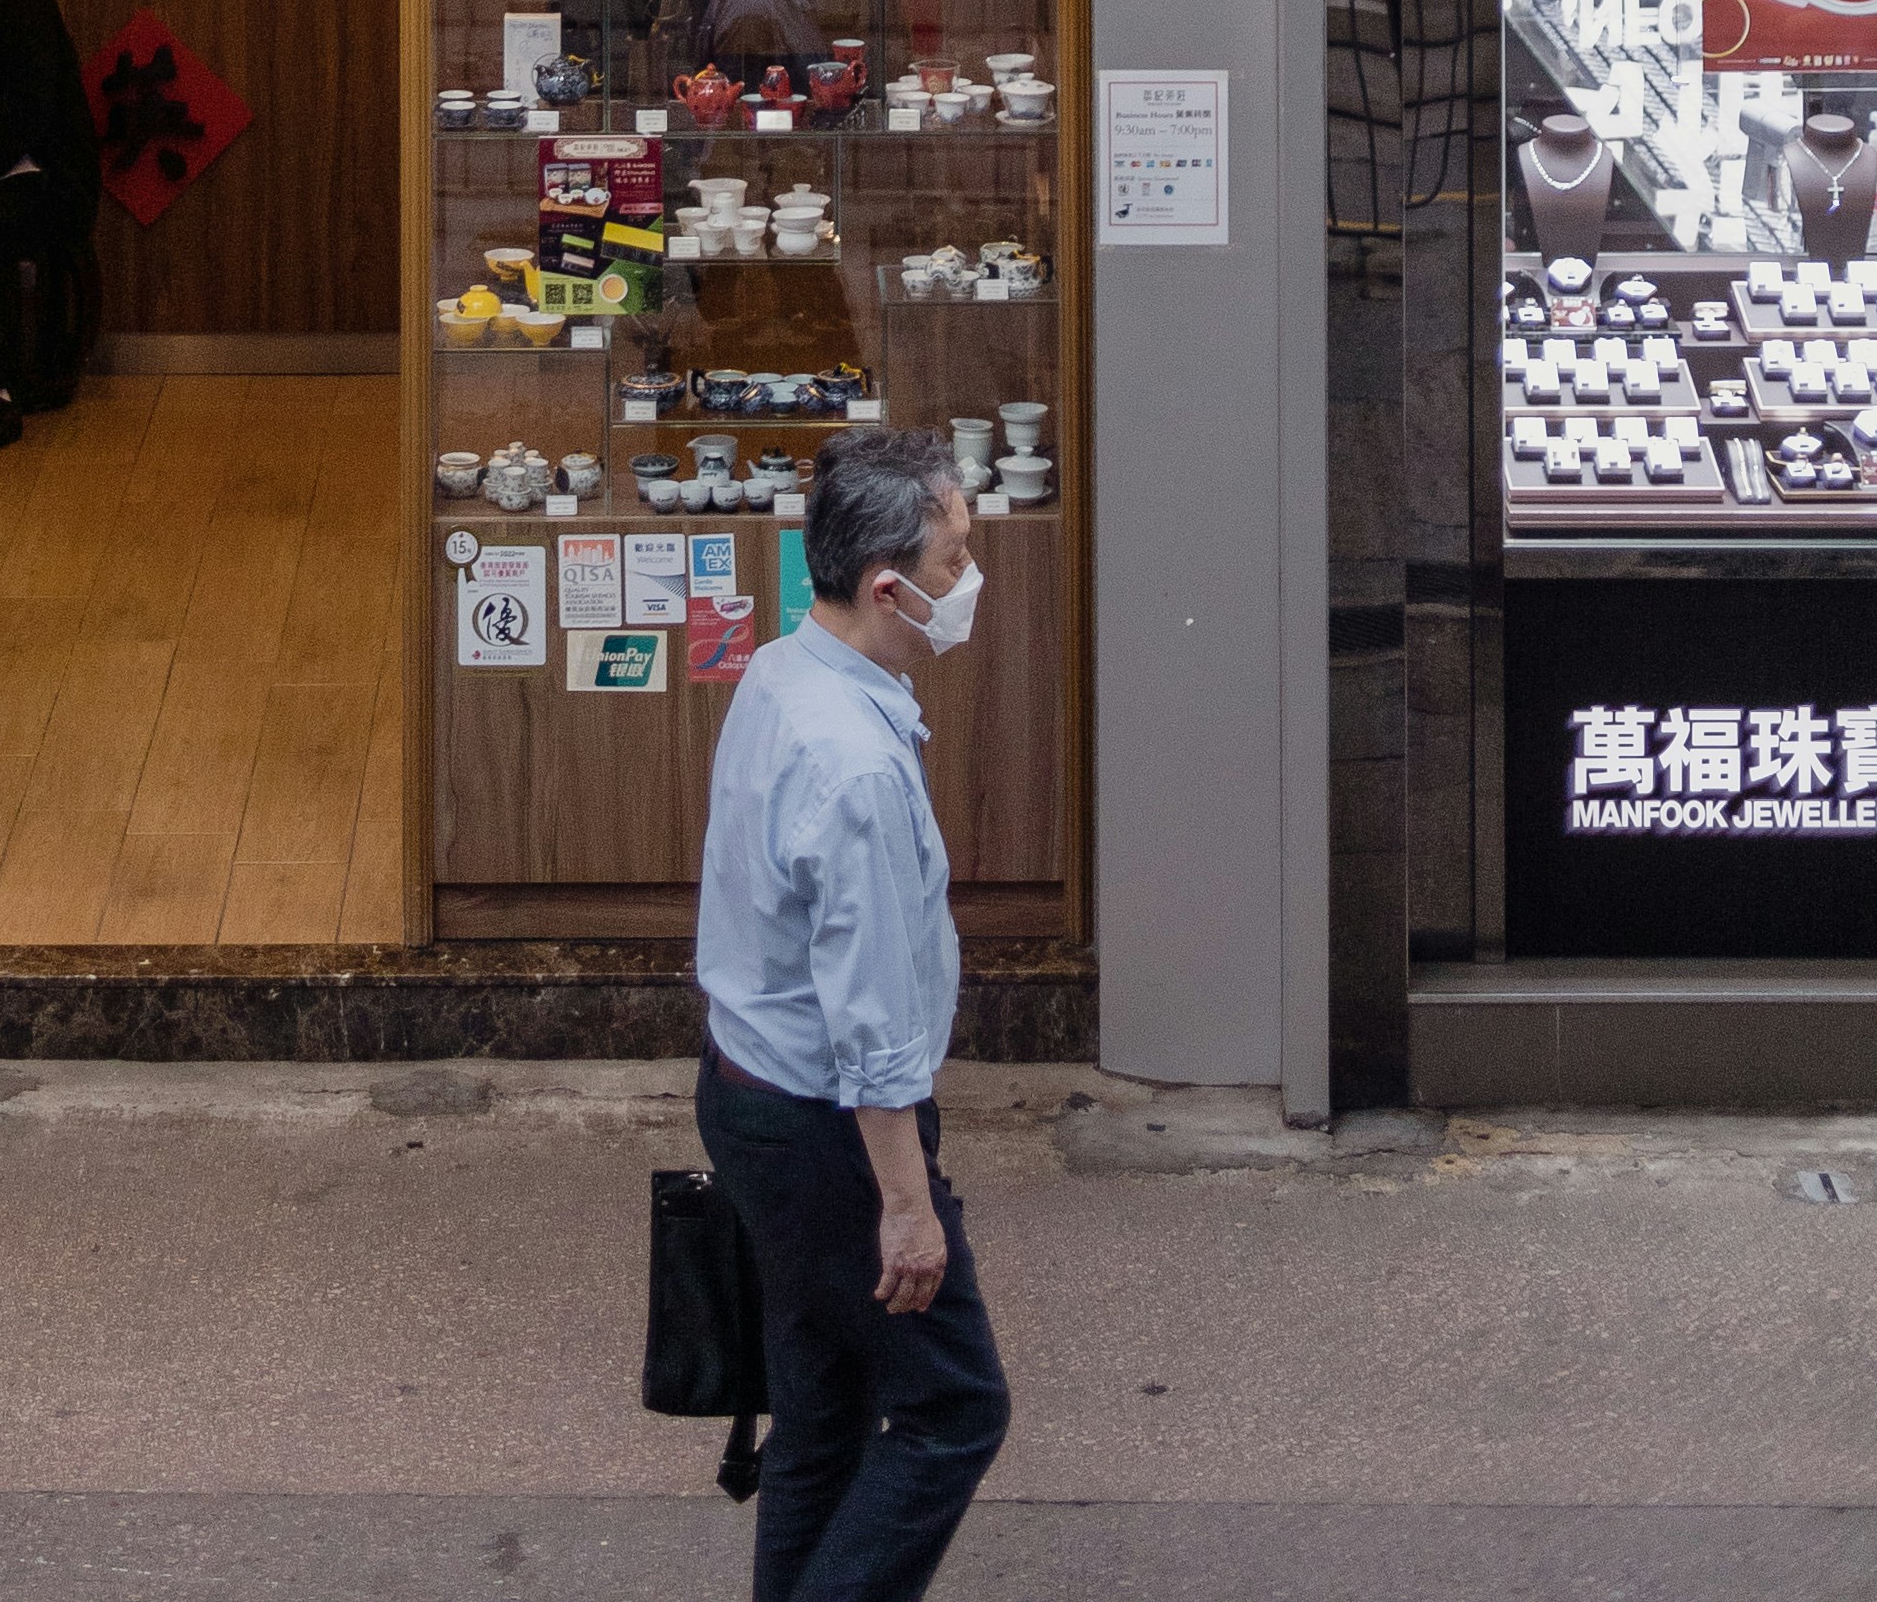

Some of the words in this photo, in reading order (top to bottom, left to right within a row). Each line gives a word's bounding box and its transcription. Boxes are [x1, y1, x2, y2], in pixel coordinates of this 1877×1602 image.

[1114, 123, 1156, 136] 9:30am
[1169, 123, 1213, 139] 7:00pm
[703, 545, 732, 558] AM
[599, 648, 652, 665] nionPay
[1572, 799, 1729, 829] MANFOOK
[1731, 799, 1877, 829] JEWELLE
